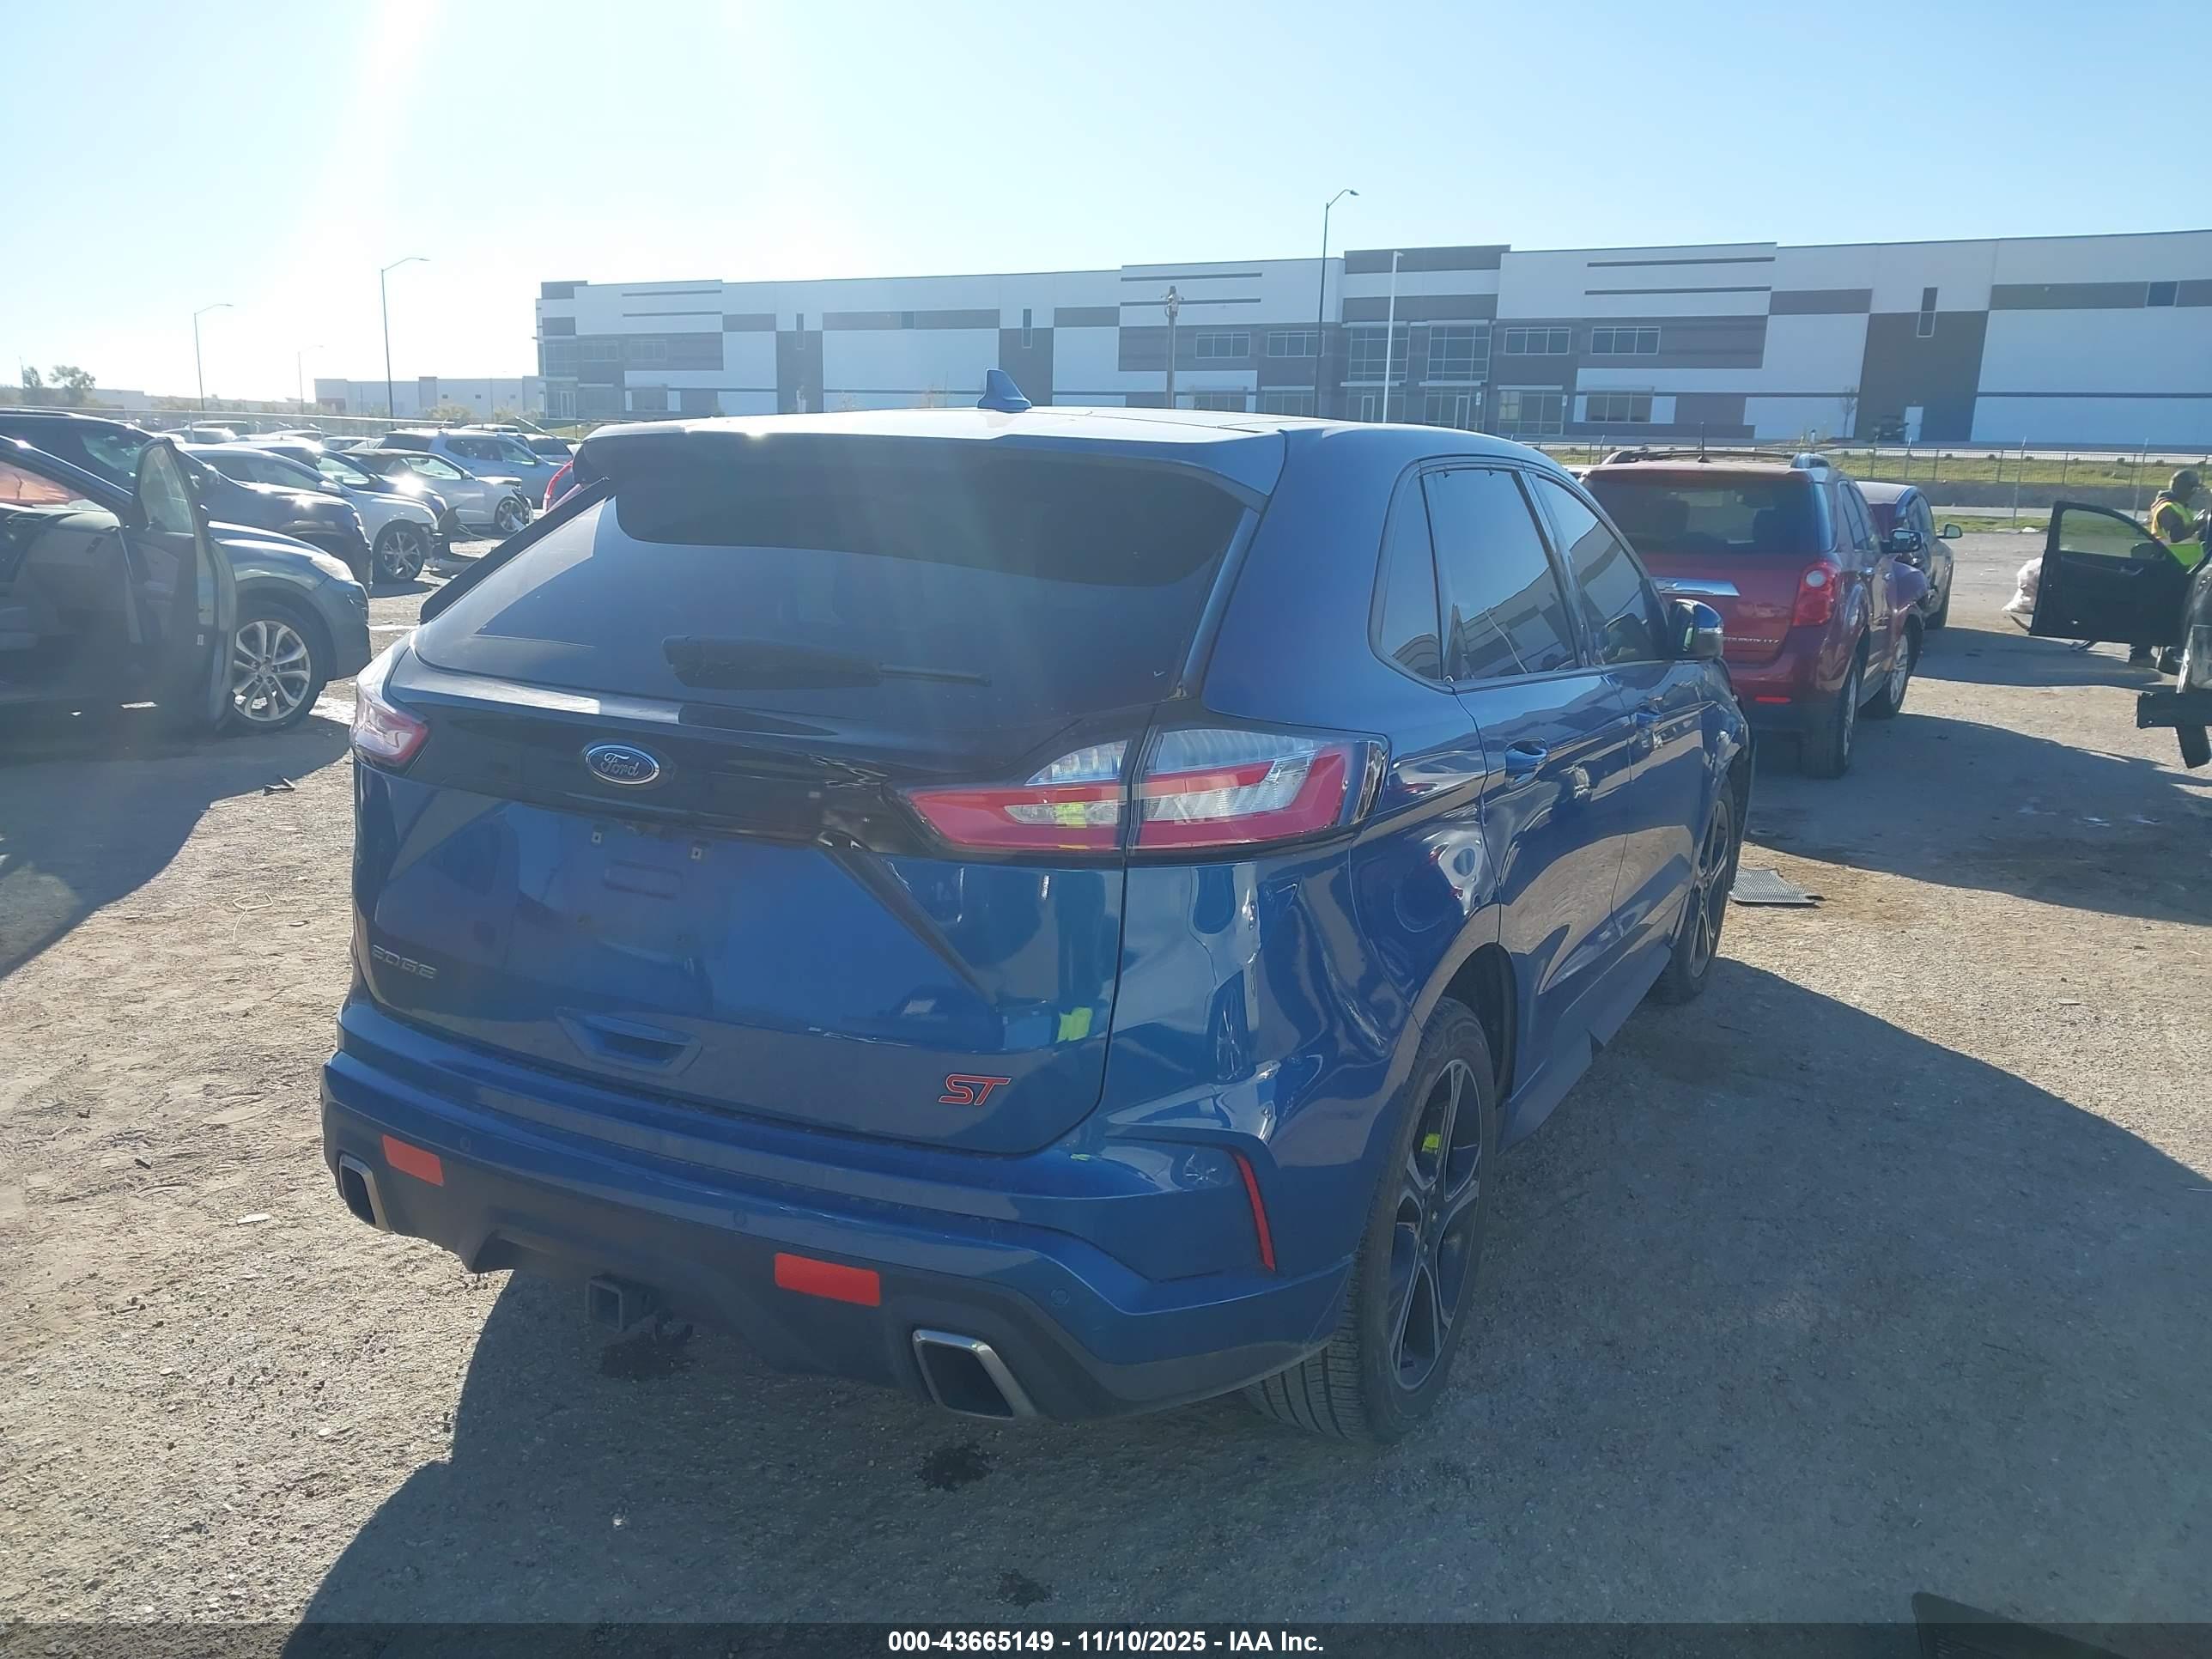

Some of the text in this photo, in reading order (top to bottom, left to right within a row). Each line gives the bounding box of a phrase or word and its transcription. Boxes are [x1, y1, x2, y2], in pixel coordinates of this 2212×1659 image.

[600, 752, 640, 777] Ford
[371, 944, 437, 979] EDGE
[938, 1073, 1012, 1106] ST
